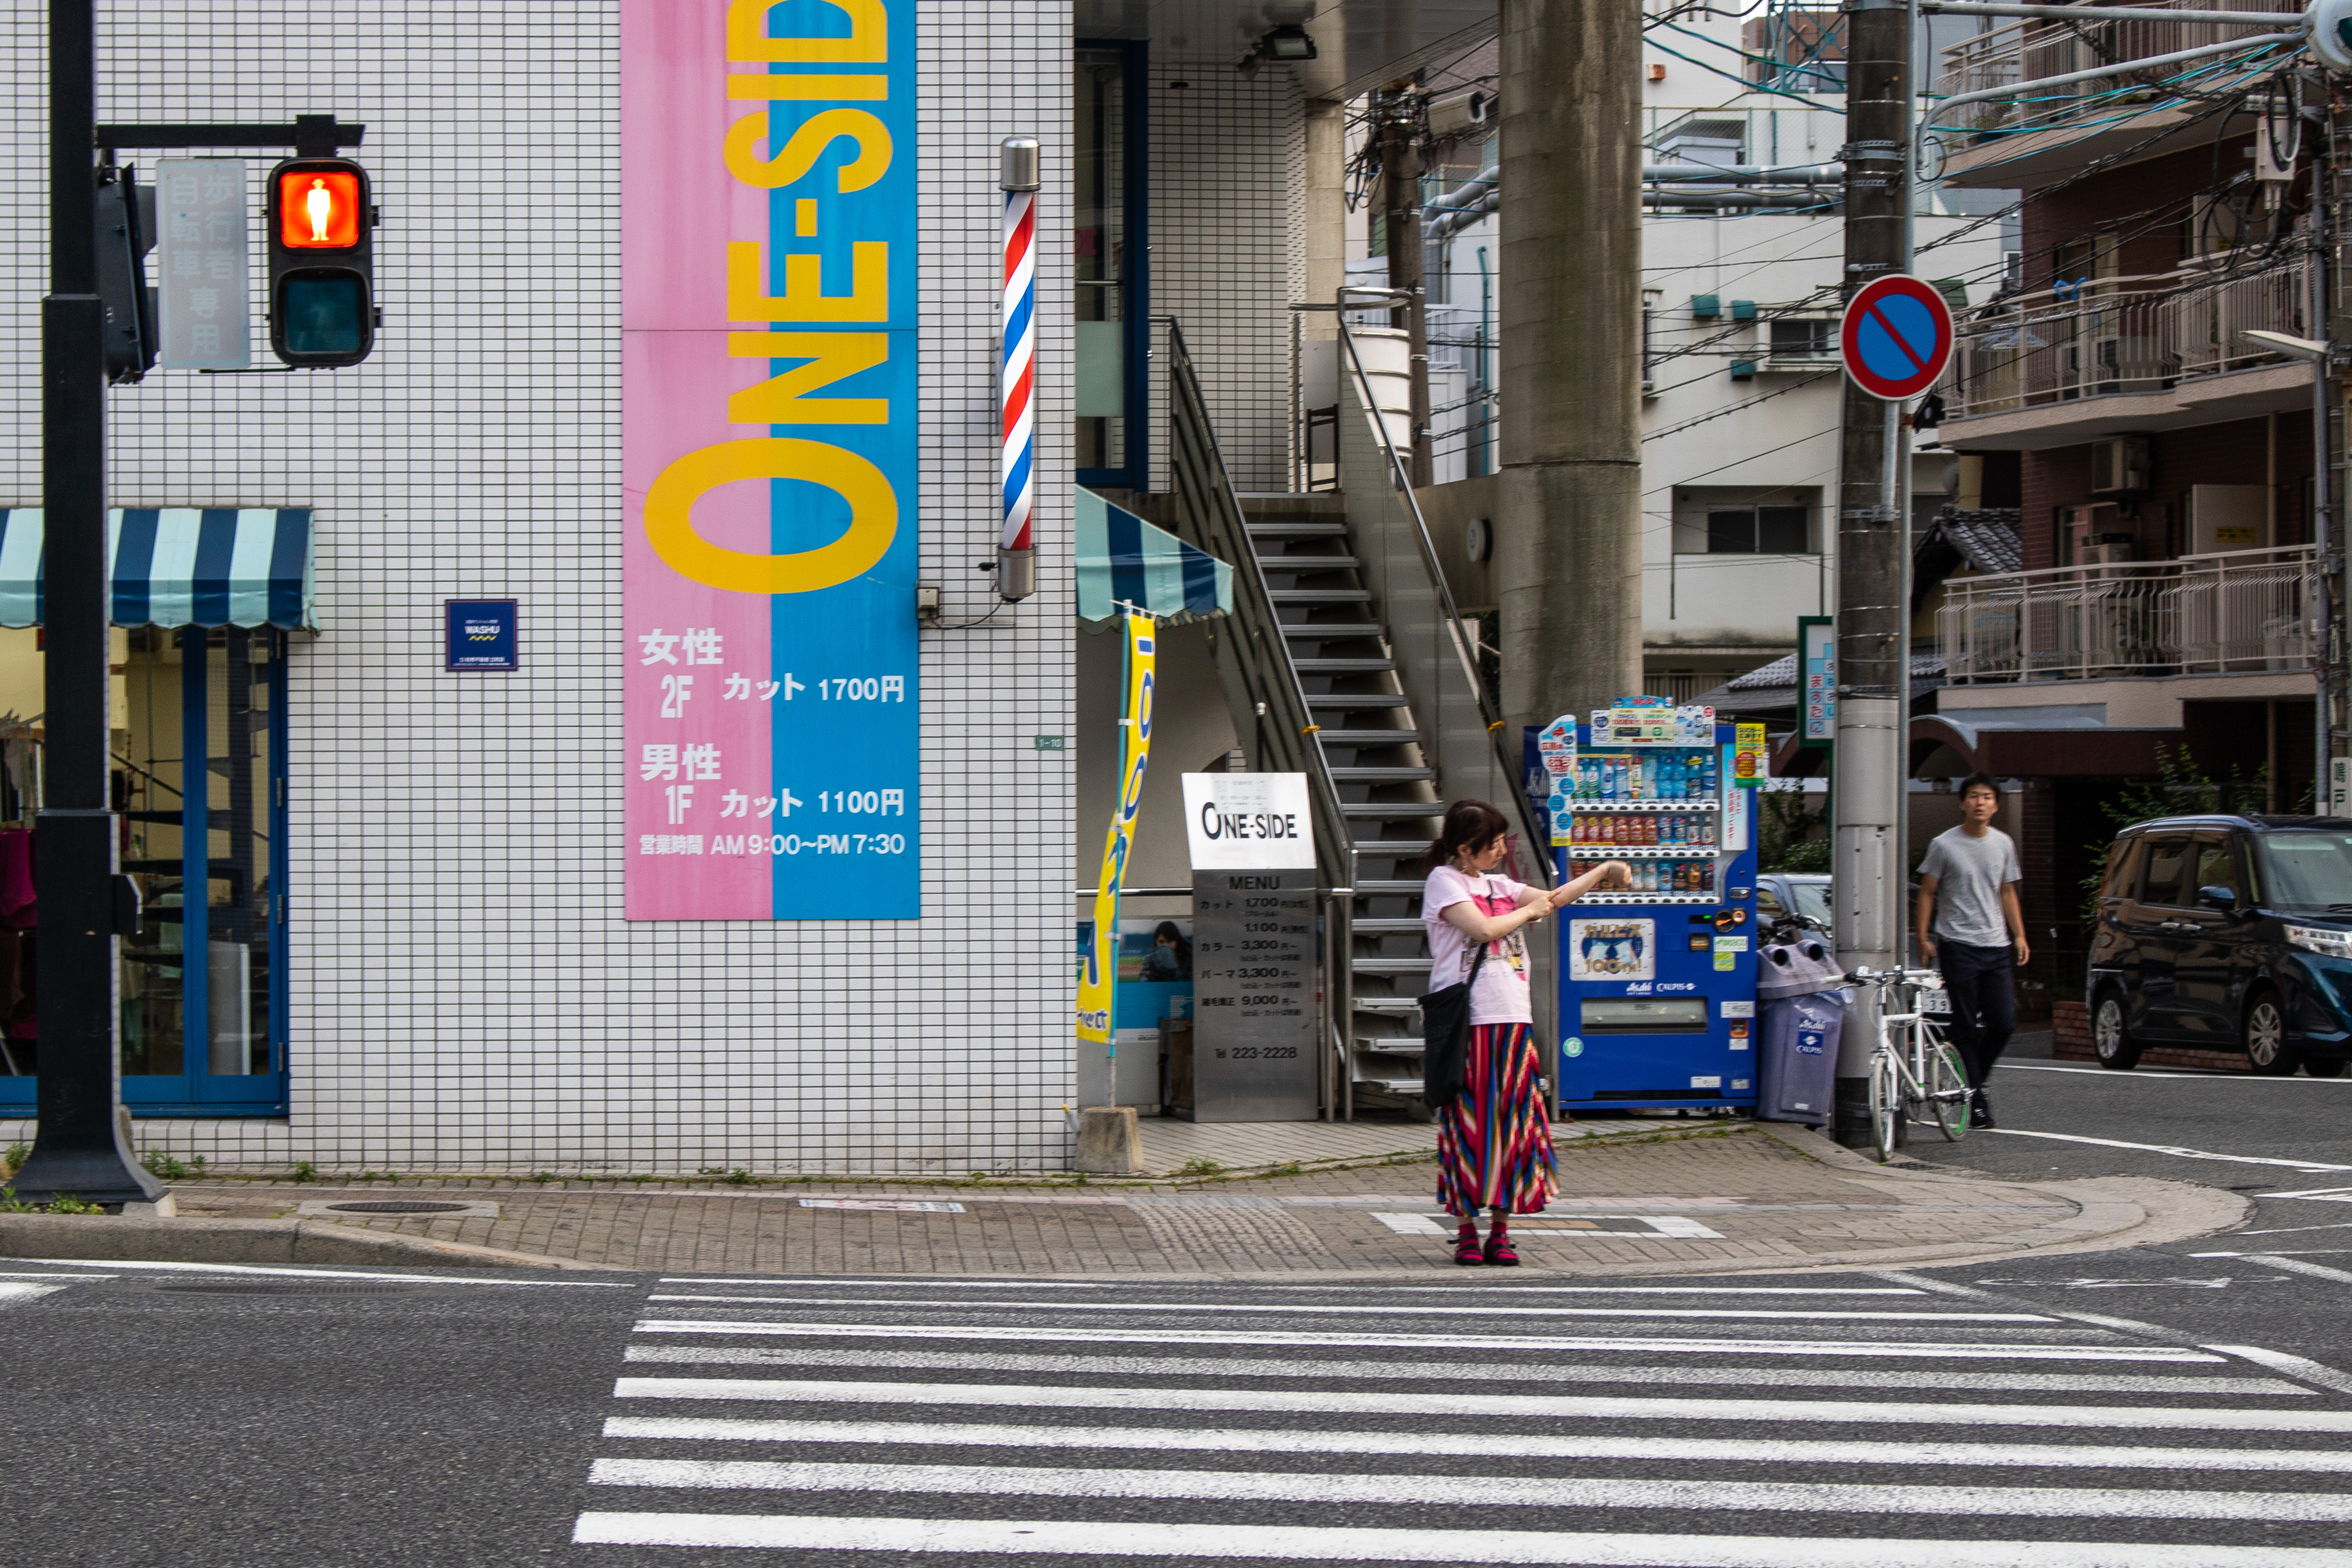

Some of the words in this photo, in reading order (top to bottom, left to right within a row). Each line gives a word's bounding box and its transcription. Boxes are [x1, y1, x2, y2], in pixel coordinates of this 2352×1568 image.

[638, 628, 724, 666] 女性
[661, 674, 693, 718] 2F
[722, 672, 806, 701] カット
[818, 676, 904, 702] 1700円
[1039, 739, 1062, 747] 1-10
[640, 743, 722, 781] 男性
[665, 785, 694, 825] 1F
[719, 788, 804, 818] カット
[818, 789, 904, 816] 1100円
[1202, 802, 1298, 840] ONE-SIDE
[639, 834, 704, 855] 営業時間
[1229, 876, 1281, 890] MENU
[1200, 900, 1234, 909] カット
[1201, 943, 1234, 951] カラー
[1201, 970, 1235, 979] パーマ
[1232, 1047, 1298, 1058] 223-2228
